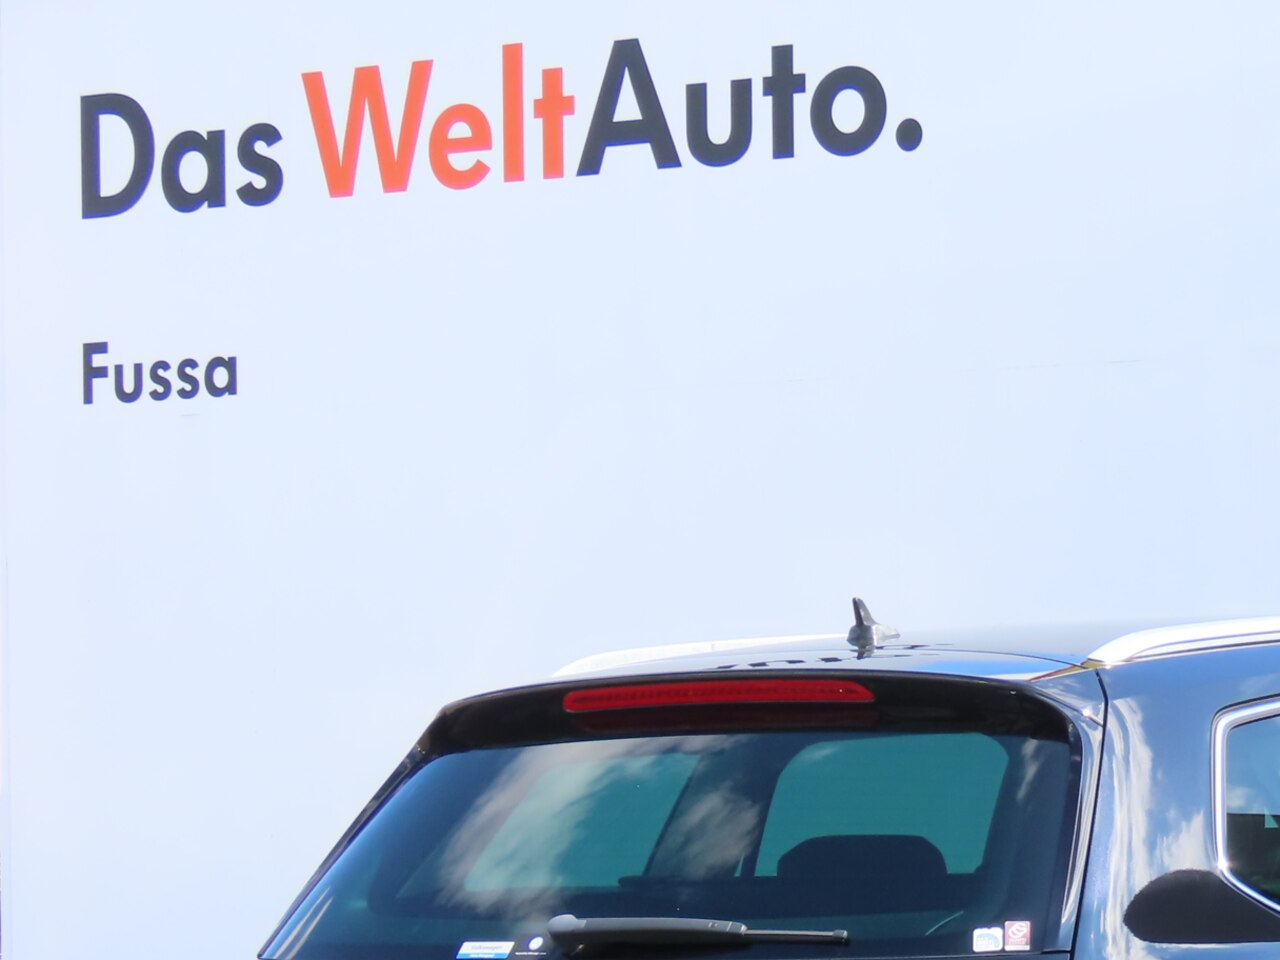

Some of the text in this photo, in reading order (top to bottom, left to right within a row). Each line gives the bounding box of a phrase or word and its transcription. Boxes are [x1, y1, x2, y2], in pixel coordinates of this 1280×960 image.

[80, 38, 923, 219] Das WeltAuto.
[83, 342, 237, 404] Fussa
